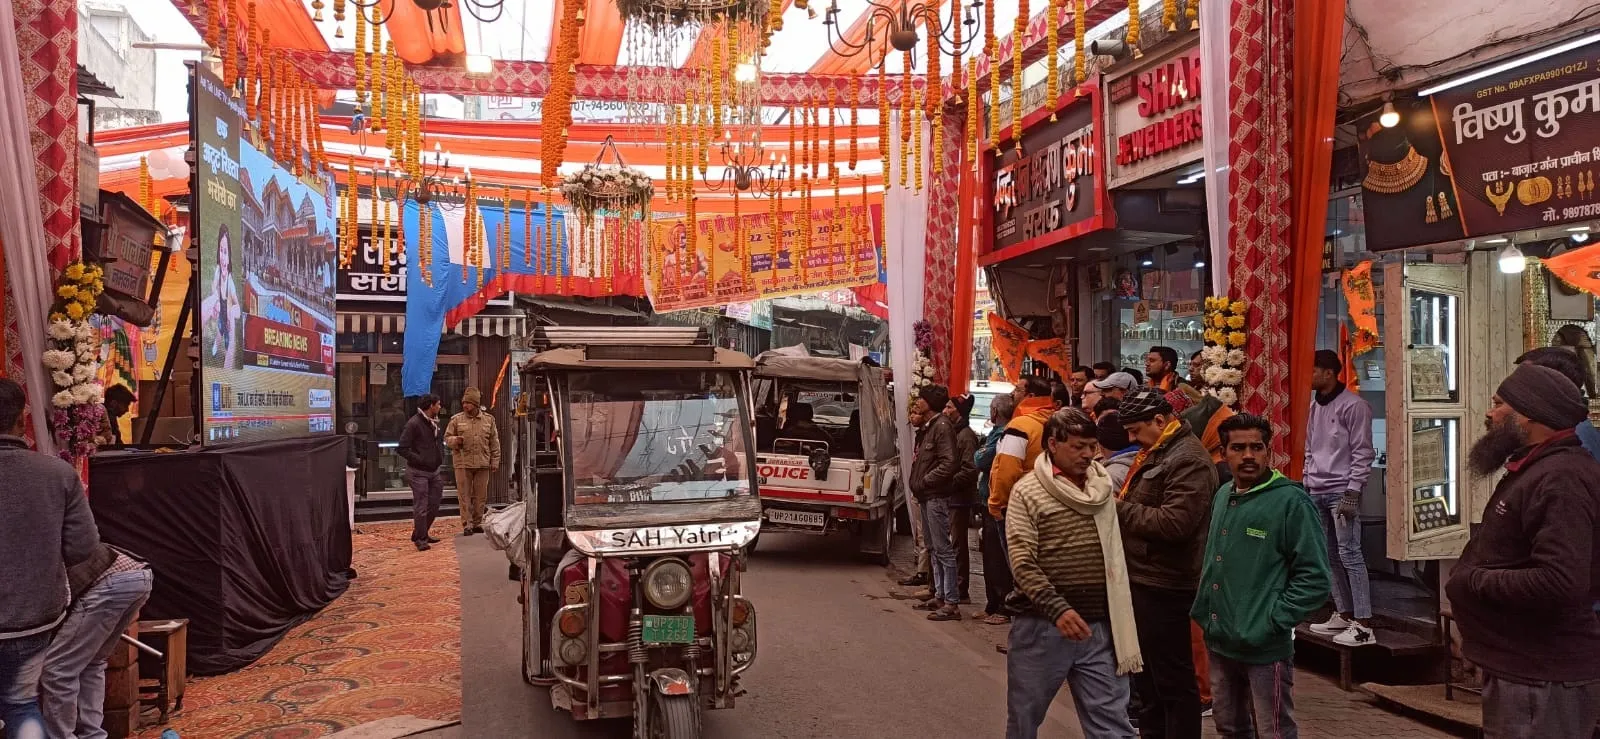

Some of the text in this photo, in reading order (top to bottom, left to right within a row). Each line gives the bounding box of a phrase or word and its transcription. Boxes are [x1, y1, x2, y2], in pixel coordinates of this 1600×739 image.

[1477, 87, 1492, 99] GST
[1494, 84, 1508, 95] No.
[1116, 104, 1202, 165] JEWELLERS
[1452, 98, 1526, 144] विष्णु
[1062, 123, 1094, 212] कुमा
[264, 327, 293, 351] BREAKING
[293, 335, 308, 353] NEWS
[612, 526, 722, 547] SAH Yatri
